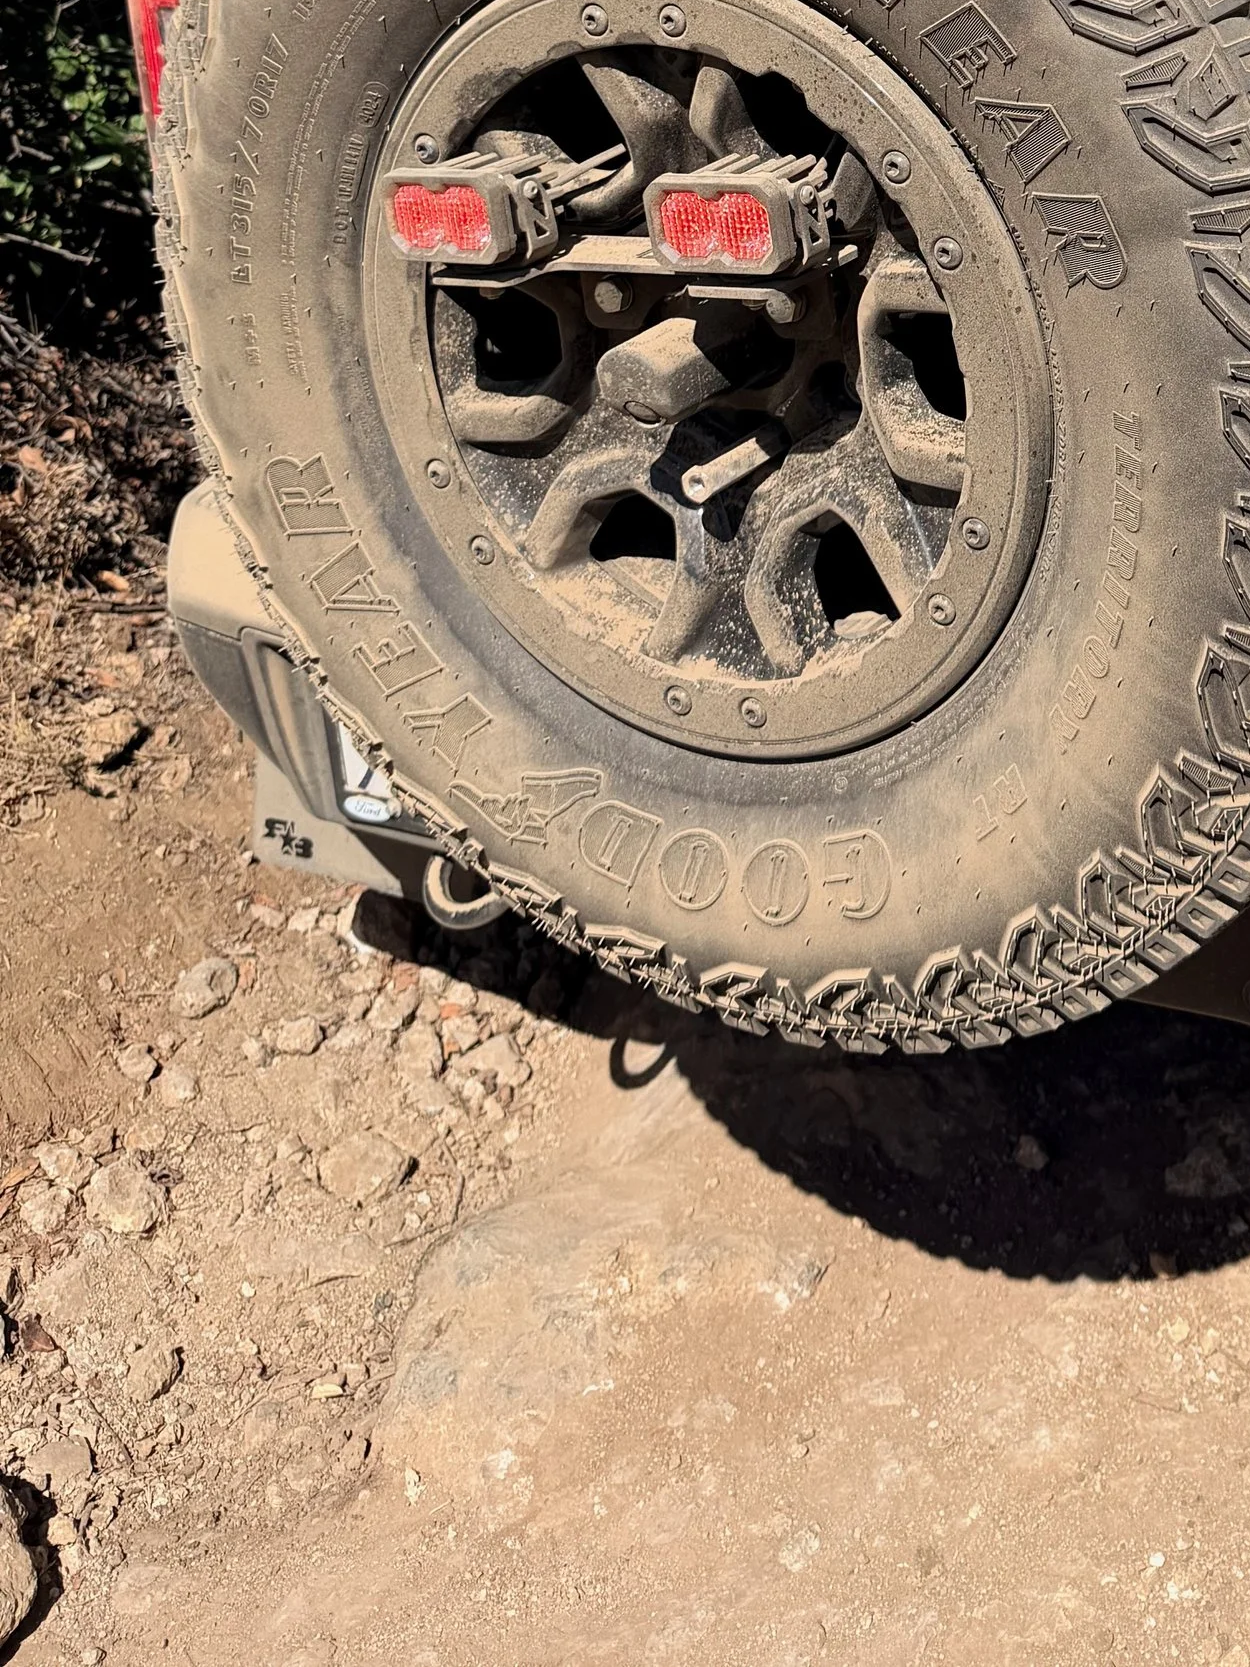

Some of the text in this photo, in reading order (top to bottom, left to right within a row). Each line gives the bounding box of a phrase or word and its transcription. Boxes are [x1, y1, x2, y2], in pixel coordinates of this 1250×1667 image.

[357, 90, 384, 124] 4024
[231, 33, 292, 285] LT315/70R17
[333, 205, 350, 245] DOT
[246, 312, 263, 366] M+S
[1048, 410, 1144, 754] TERRITORY
[265, 452, 893, 926] GOODYEAR
[972, 762, 1029, 843] RT
